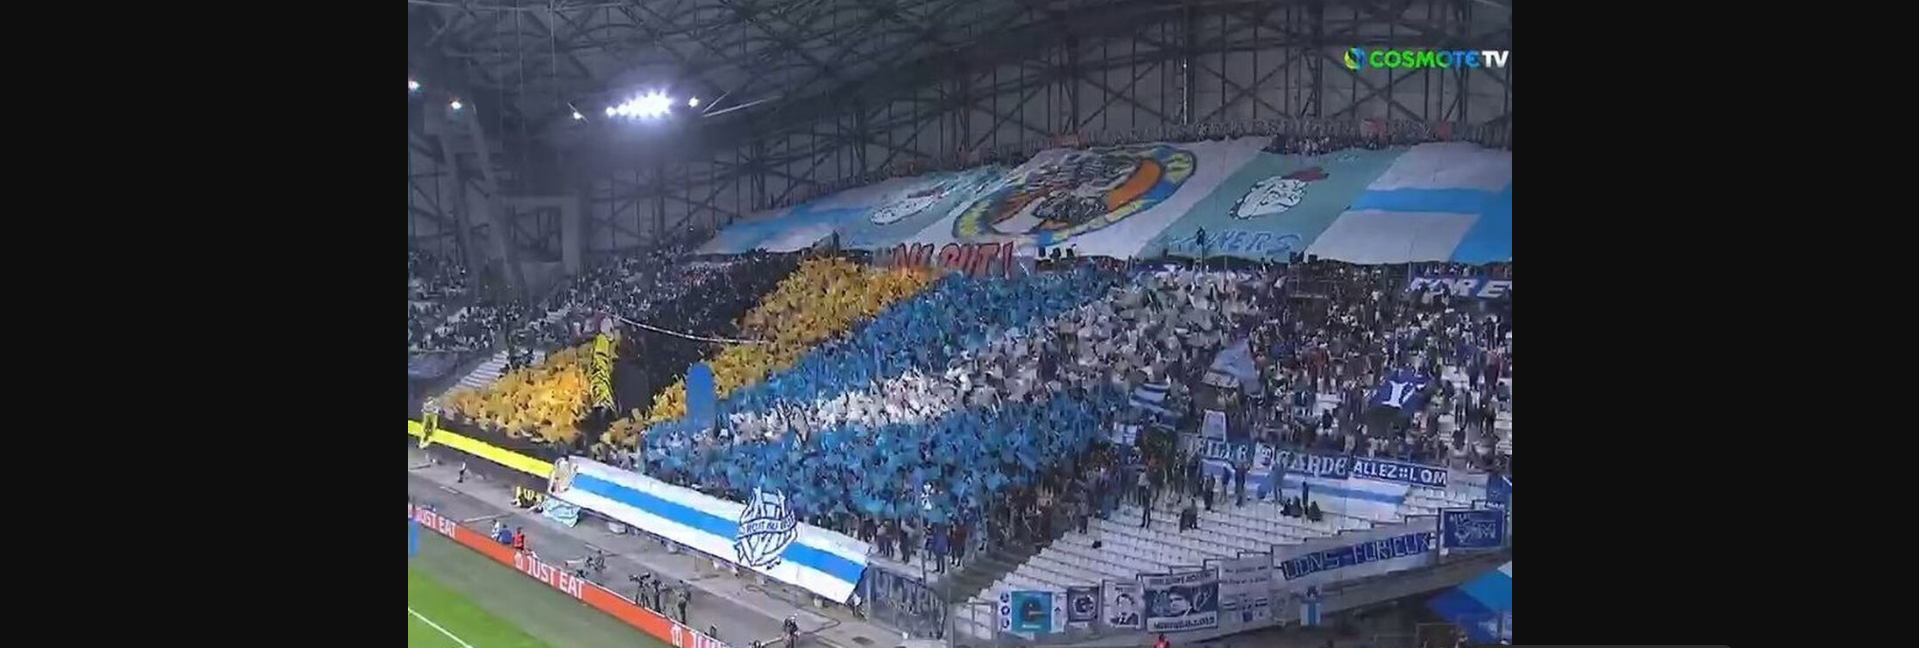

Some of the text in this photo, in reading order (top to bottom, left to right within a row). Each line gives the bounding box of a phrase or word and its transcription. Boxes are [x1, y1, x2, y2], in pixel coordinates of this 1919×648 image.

[1353, 460, 1397, 479] ALLEZ
[438, 516, 457, 539] EAT
[526, 555, 586, 600] JUST EAT
